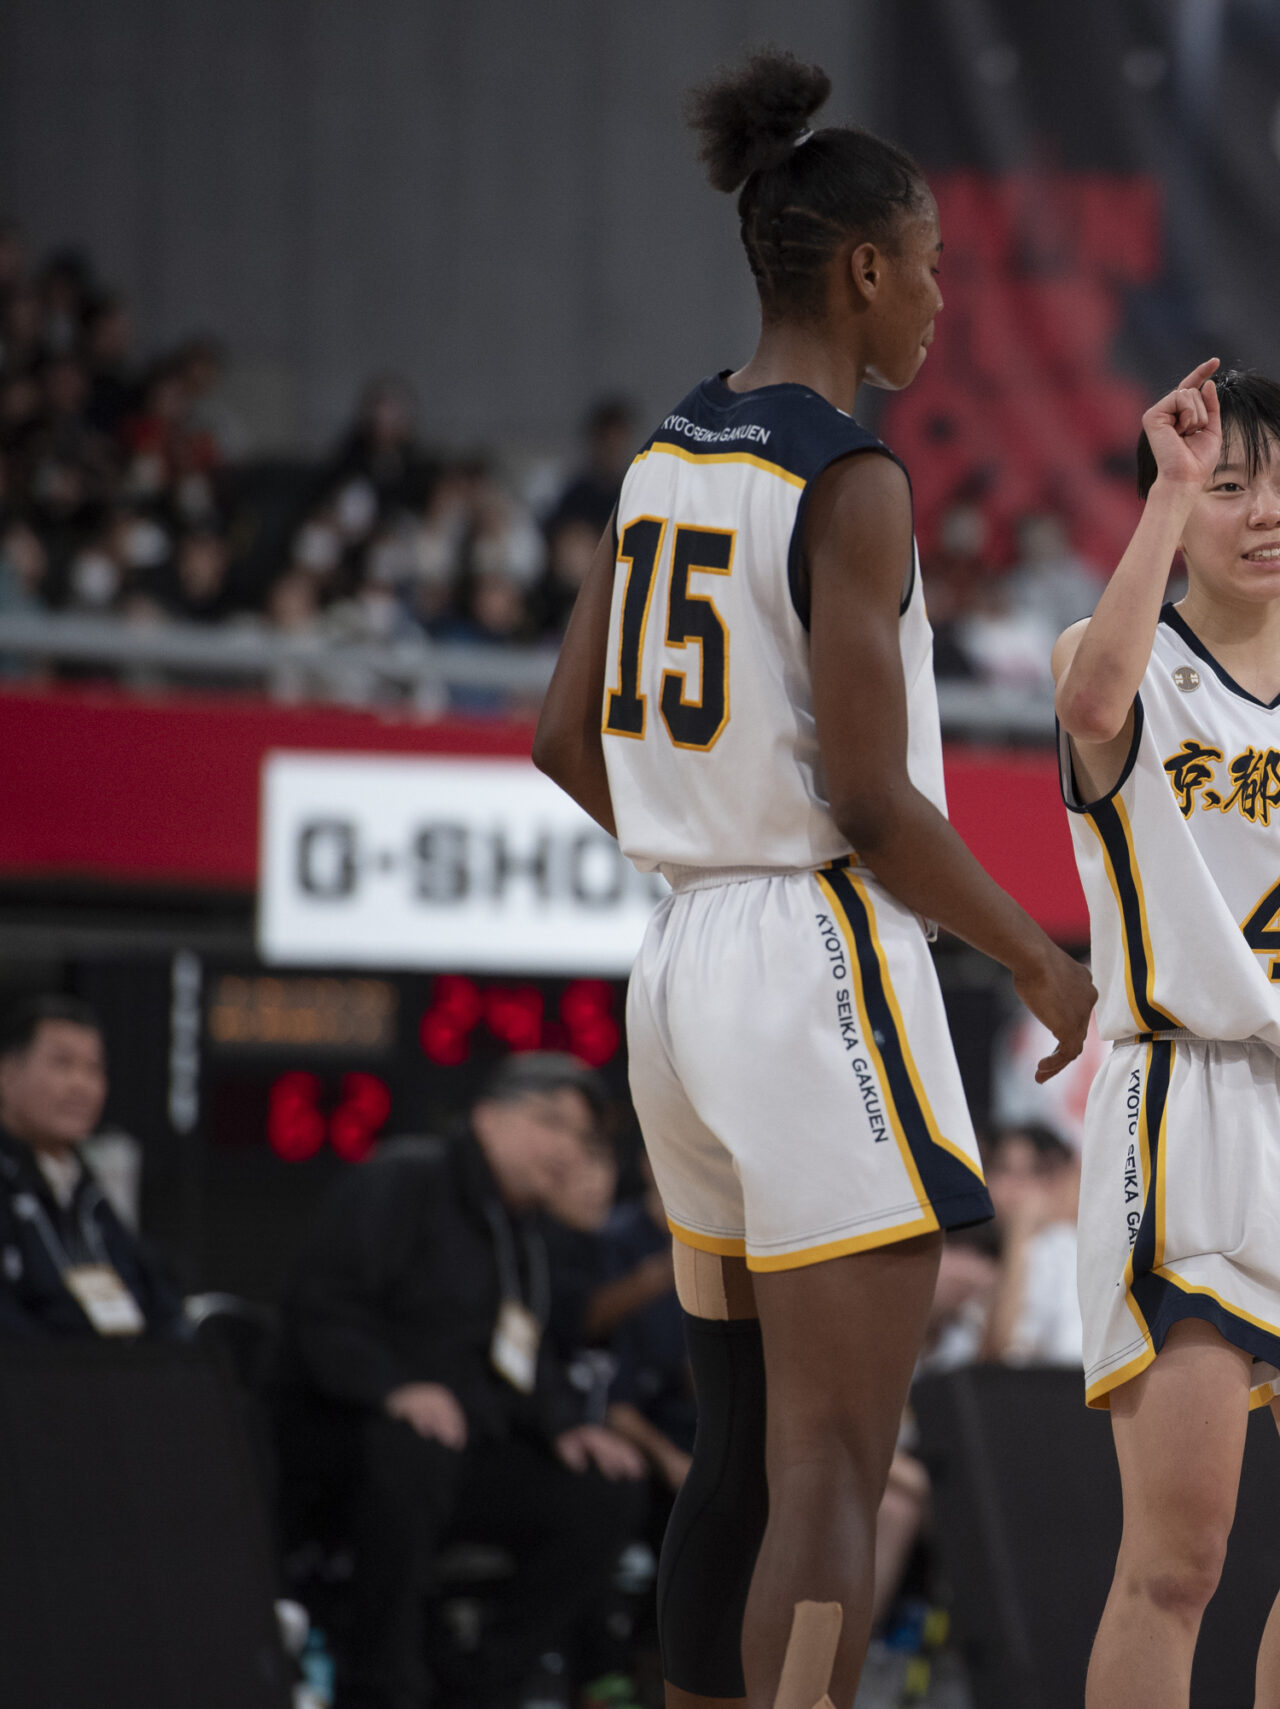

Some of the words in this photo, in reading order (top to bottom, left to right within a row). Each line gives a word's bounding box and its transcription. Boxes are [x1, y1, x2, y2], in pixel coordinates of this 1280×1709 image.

[661, 415, 695, 437] KYOTO
[720, 424, 771, 445] GAKUEN
[602, 513, 738, 753] 15
[815, 912, 847, 981] KYOTO
[836, 988, 859, 1051] SEIKA
[851, 1056, 889, 1144] GAKUEN
